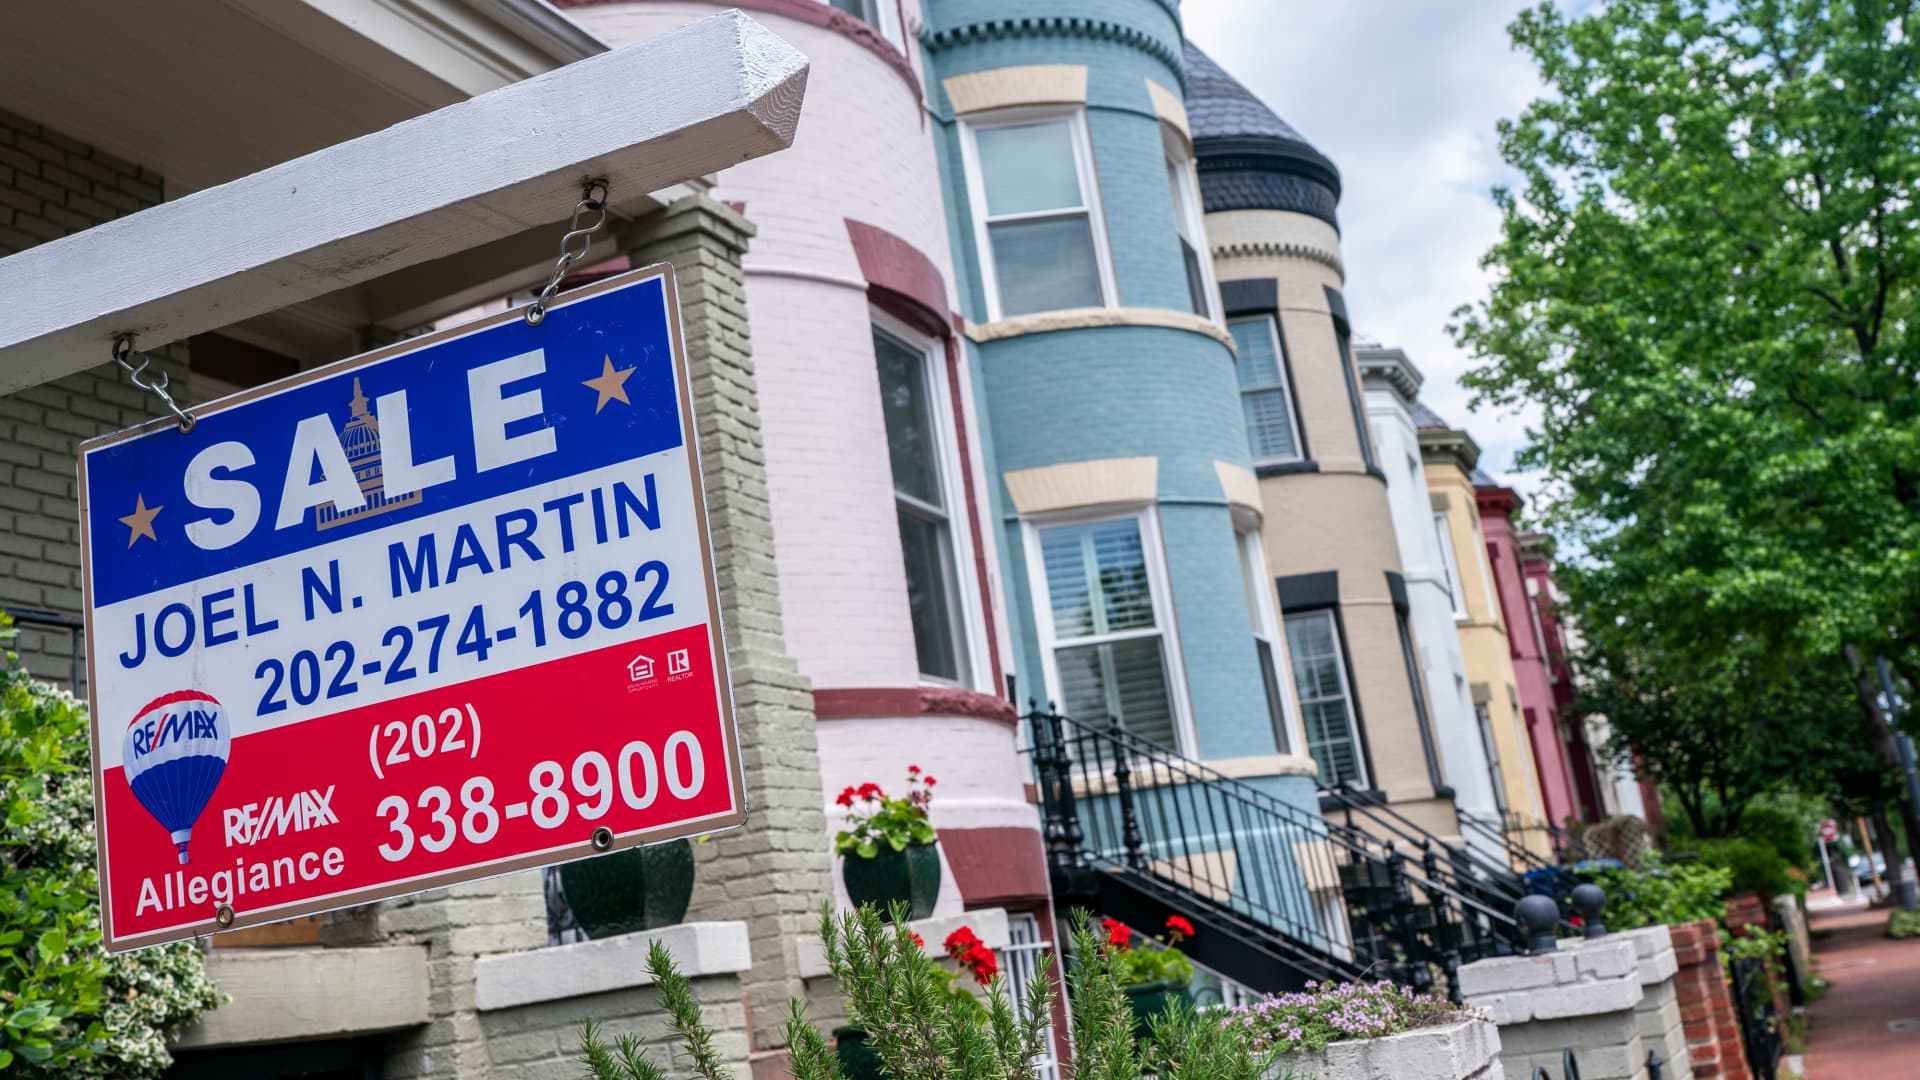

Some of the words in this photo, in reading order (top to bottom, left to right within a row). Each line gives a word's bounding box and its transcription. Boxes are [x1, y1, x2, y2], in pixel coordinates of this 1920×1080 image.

[183, 347, 557, 551] SALE
[119, 583, 279, 669] JOEL
[301, 559, 363, 622] N.
[388, 473, 661, 598] MARTIN
[254, 560, 674, 717] 202-274-1882
[132, 710, 218, 760] RE/MAX
[369, 702, 481, 780] (202)
[223, 784, 340, 848] RE/MAX
[375, 730, 705, 862] 338-8900
[135, 846, 345, 917] Allegiance
